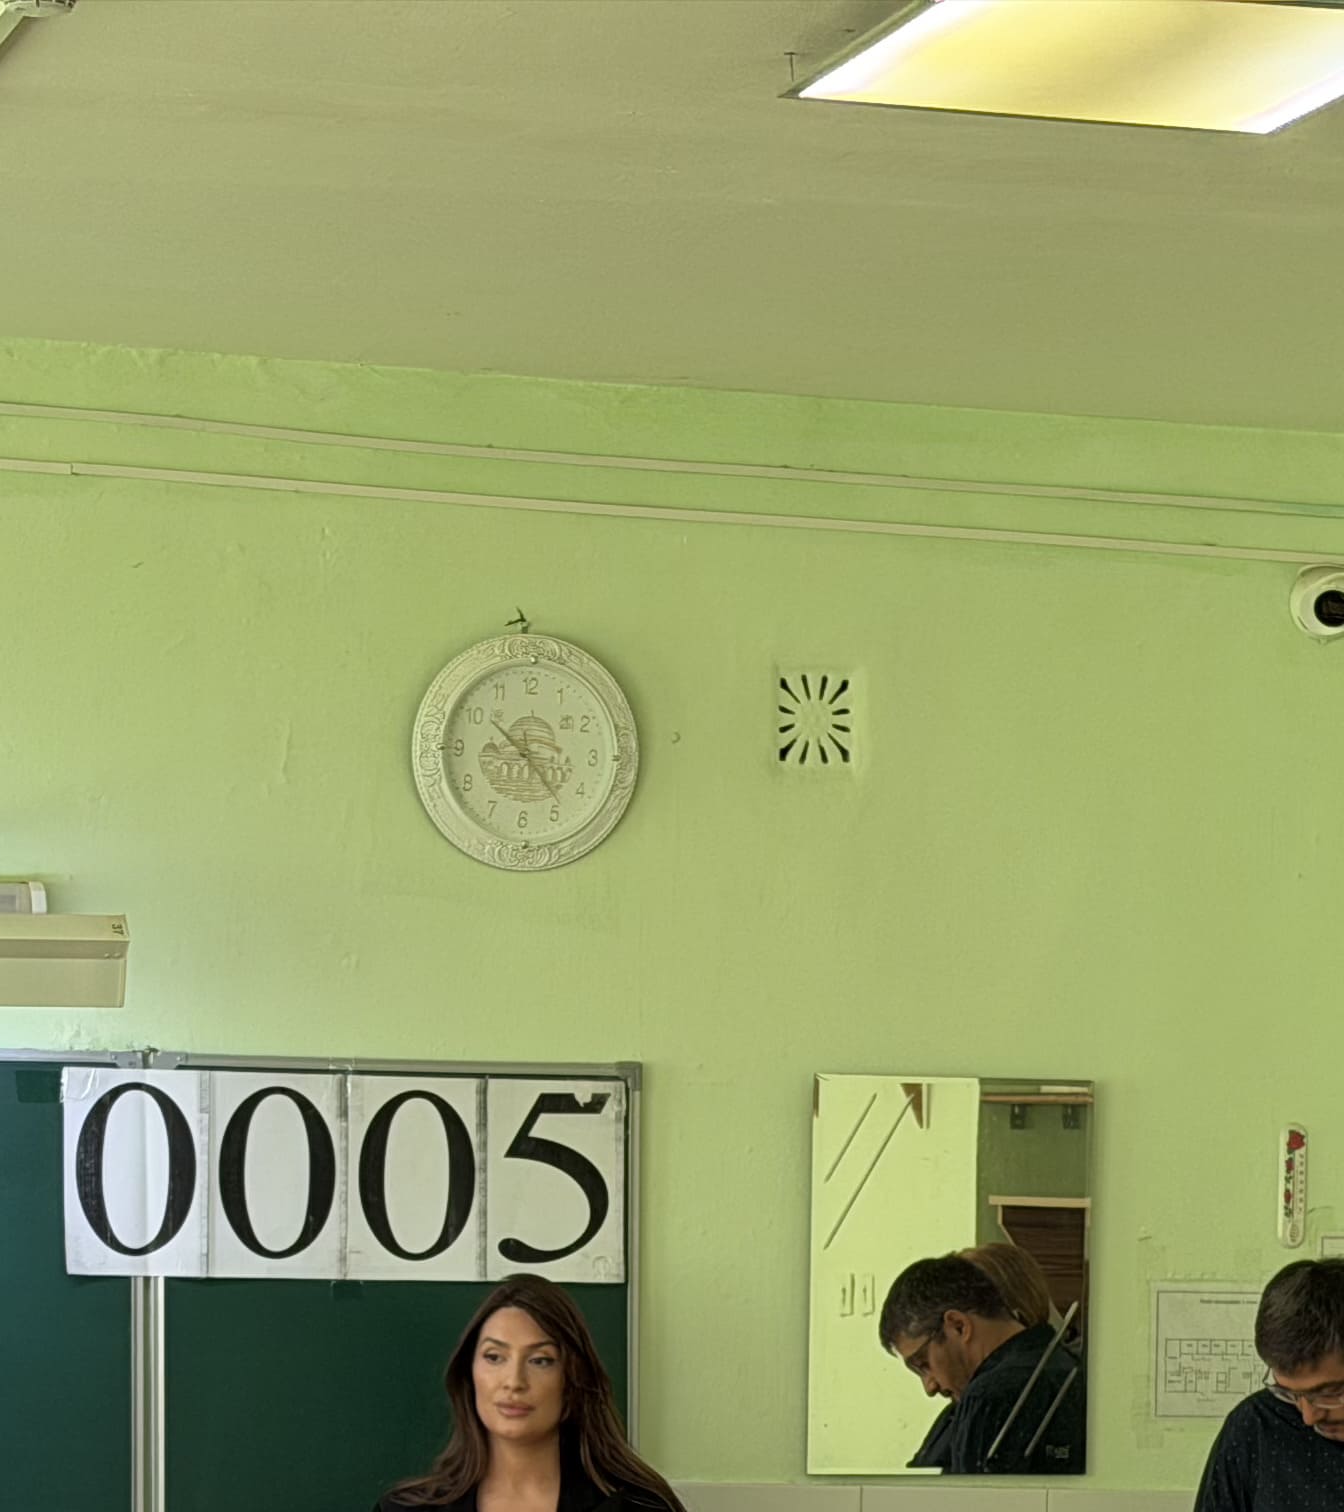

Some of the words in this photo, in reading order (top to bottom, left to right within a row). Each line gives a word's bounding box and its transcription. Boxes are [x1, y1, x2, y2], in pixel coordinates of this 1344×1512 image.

[493, 682, 505, 701] 11
[522, 676, 539, 695] 12
[556, 687, 564, 705] 1
[465, 706, 484, 725] 10
[579, 714, 591, 733] 2
[454, 739, 465, 757] 9
[587, 748, 598, 767] 3
[462, 773, 473, 792] 8
[575, 782, 585, 797] 4
[487, 800, 497, 819] 7
[549, 805, 560, 823] 5
[517, 810, 528, 829] 6
[75, 1081, 613, 1264] 0005
